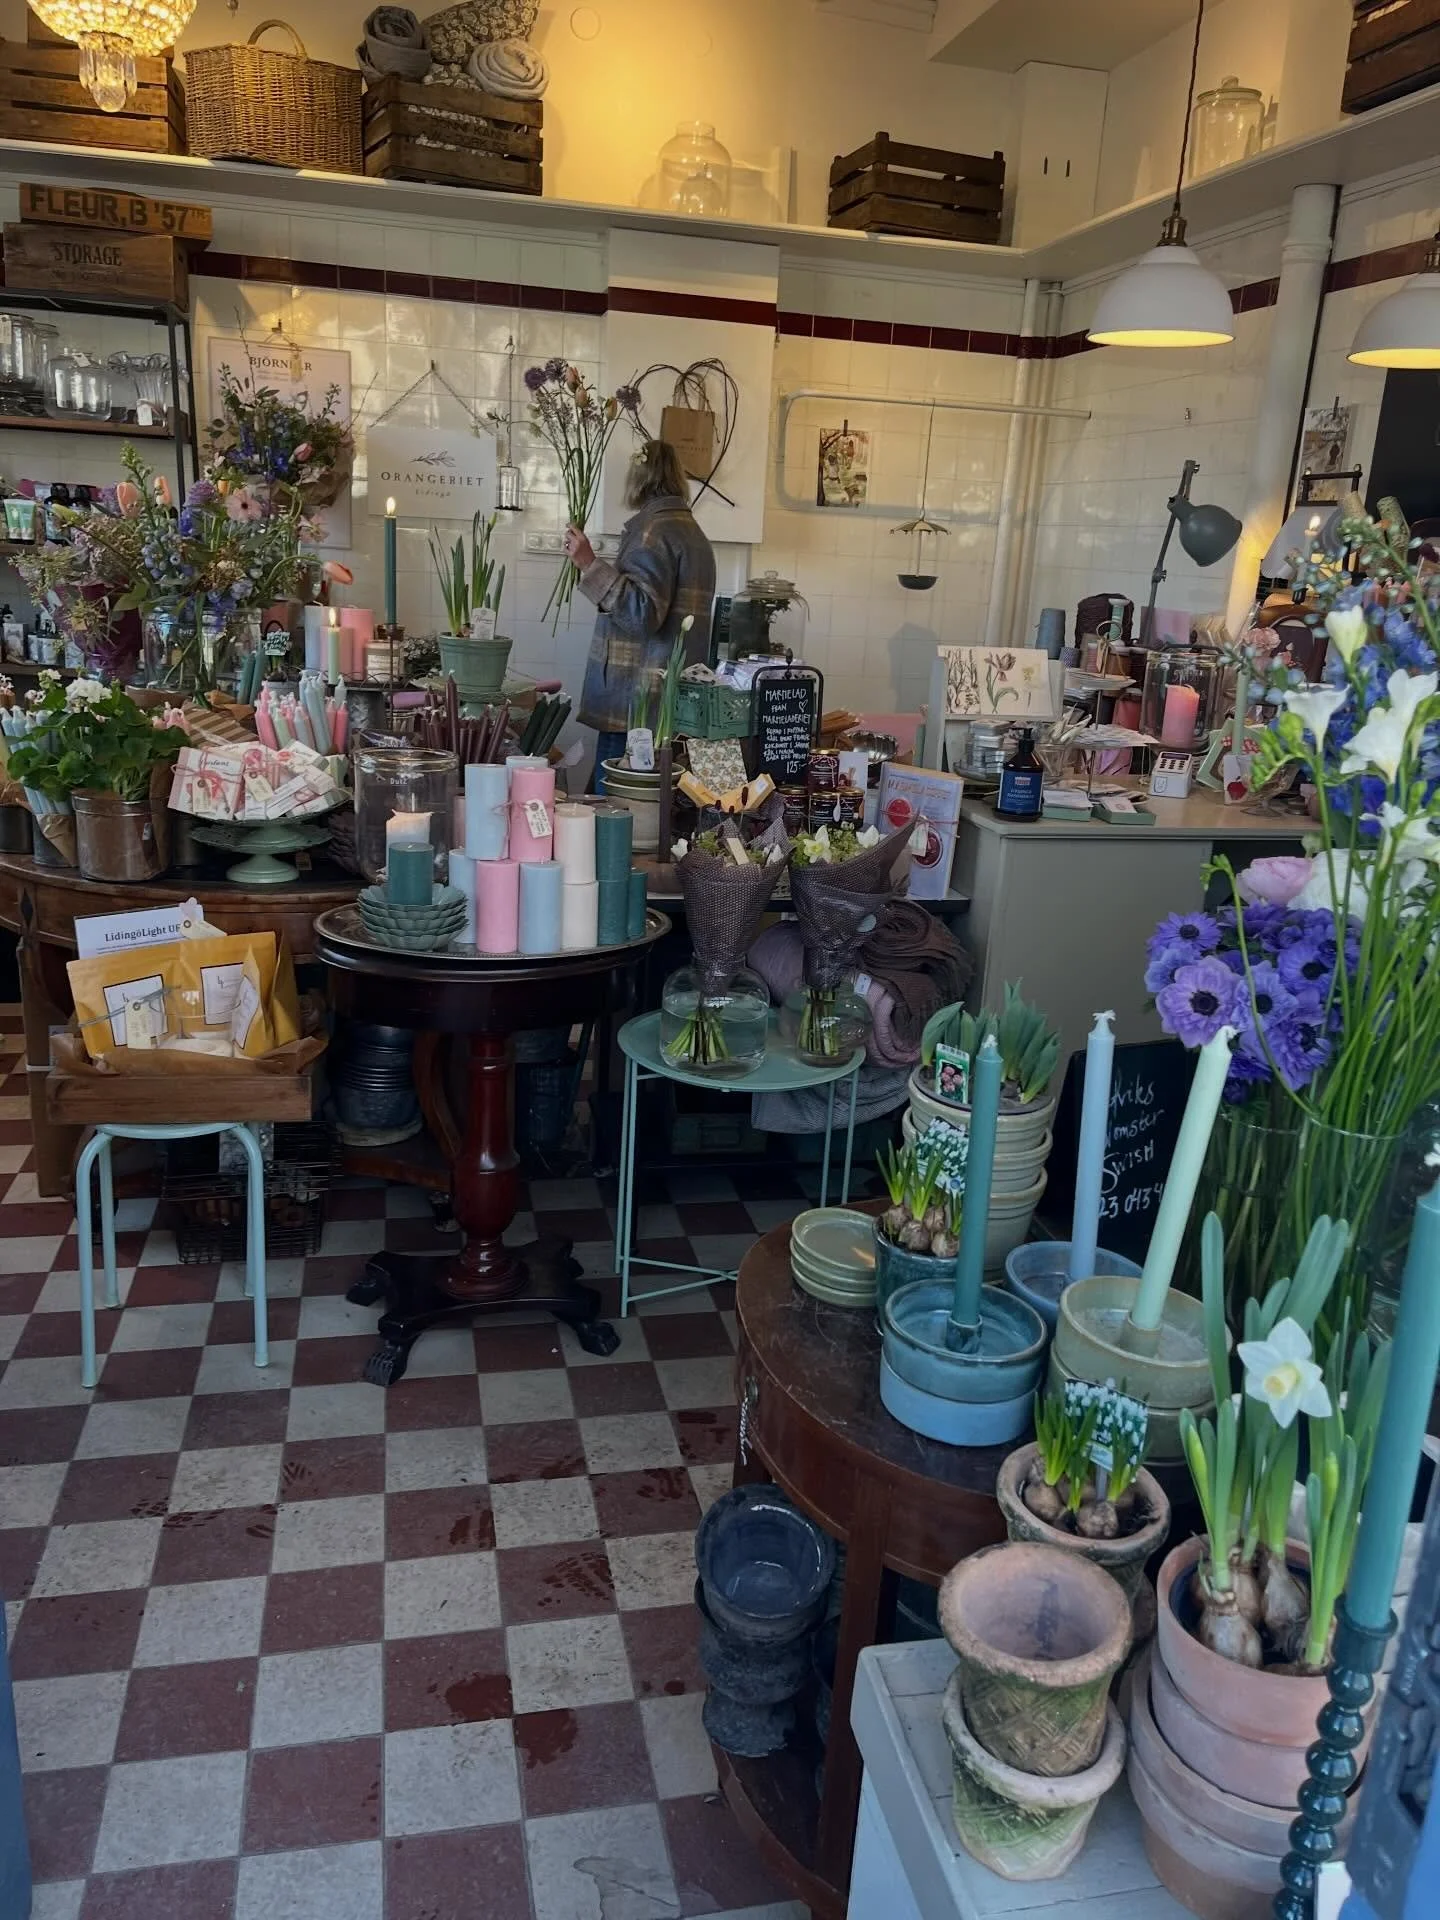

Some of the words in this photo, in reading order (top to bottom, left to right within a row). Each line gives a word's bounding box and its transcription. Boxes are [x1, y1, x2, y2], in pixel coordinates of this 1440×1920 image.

[54, 243, 122, 267] STORAGE
[249, 355, 312, 371] BJÖRNR
[381, 471, 484, 487] ORANGERIET
[765, 688, 807, 702] MARMELAD
[105, 926, 167, 942] LidingöLight
